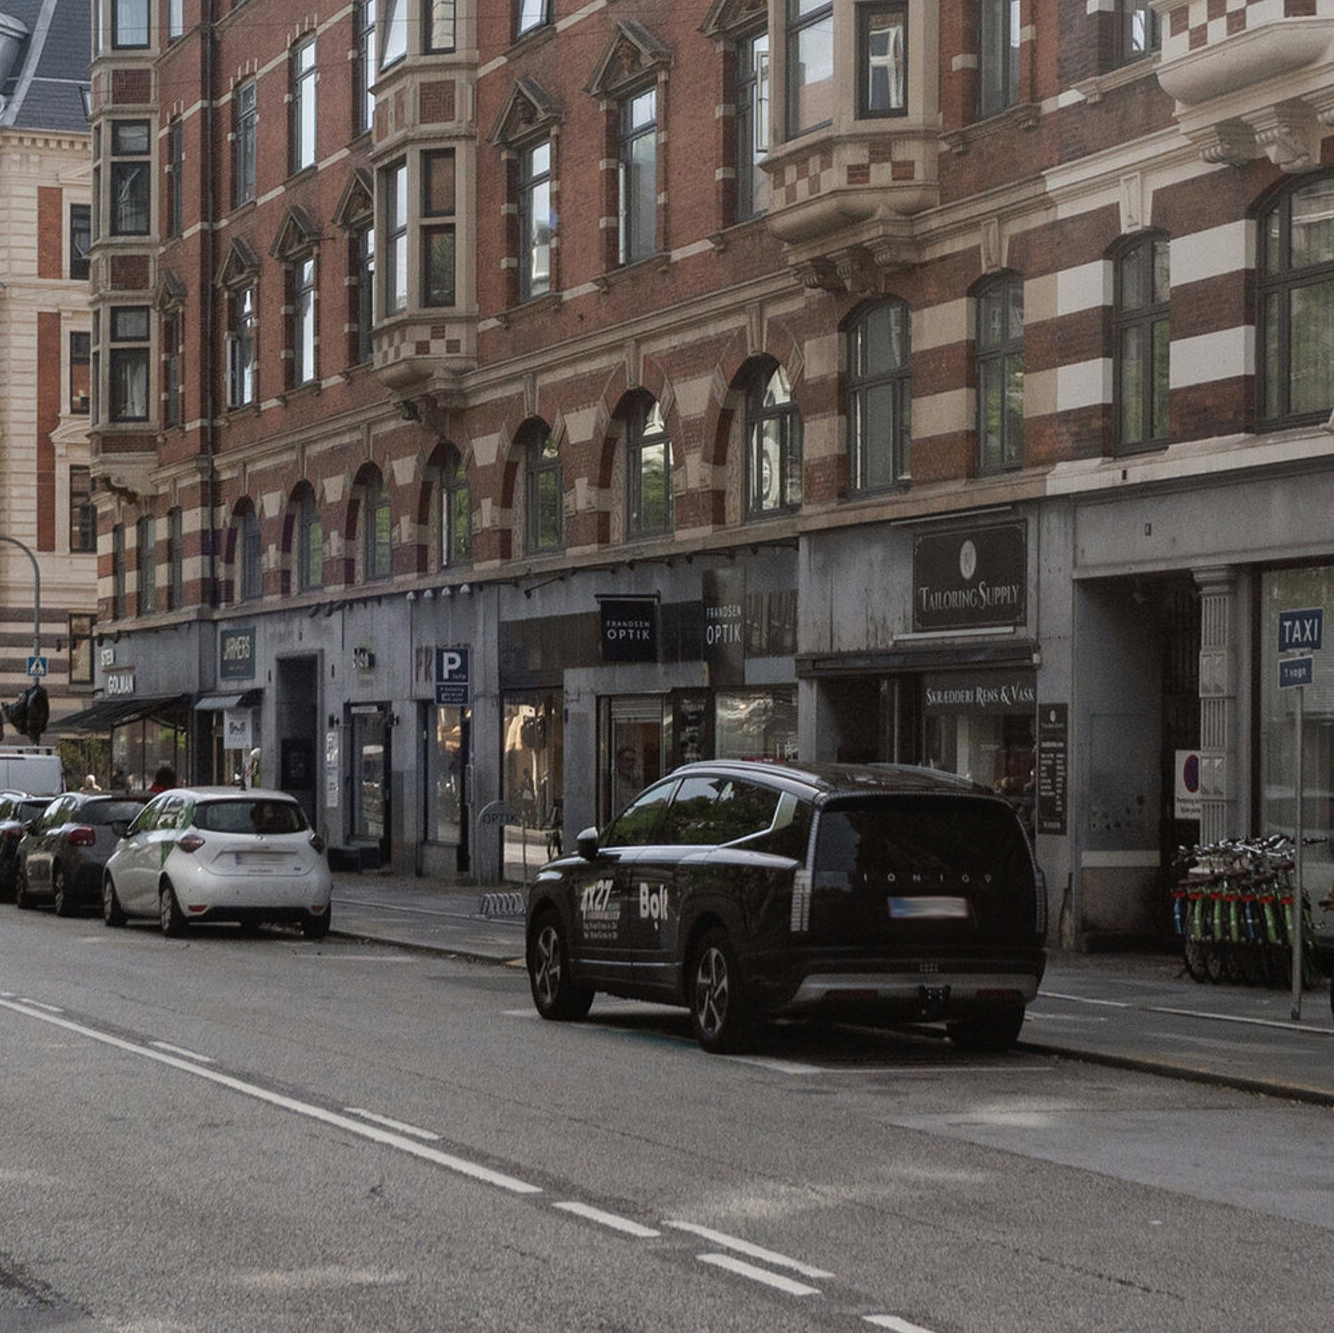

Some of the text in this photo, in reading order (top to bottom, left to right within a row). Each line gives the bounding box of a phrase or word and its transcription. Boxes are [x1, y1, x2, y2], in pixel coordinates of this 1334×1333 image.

[607, 629, 650, 640] OPTIK
[706, 623, 742, 645] OPTIK
[1283, 618, 1319, 643] TAXI
[443, 651, 462, 680] P
[976, 686, 999, 706] RENS
[1000, 685, 1011, 705] &
[1011, 682, 1035, 702] VASK
[640, 882, 669, 921] Bolt
